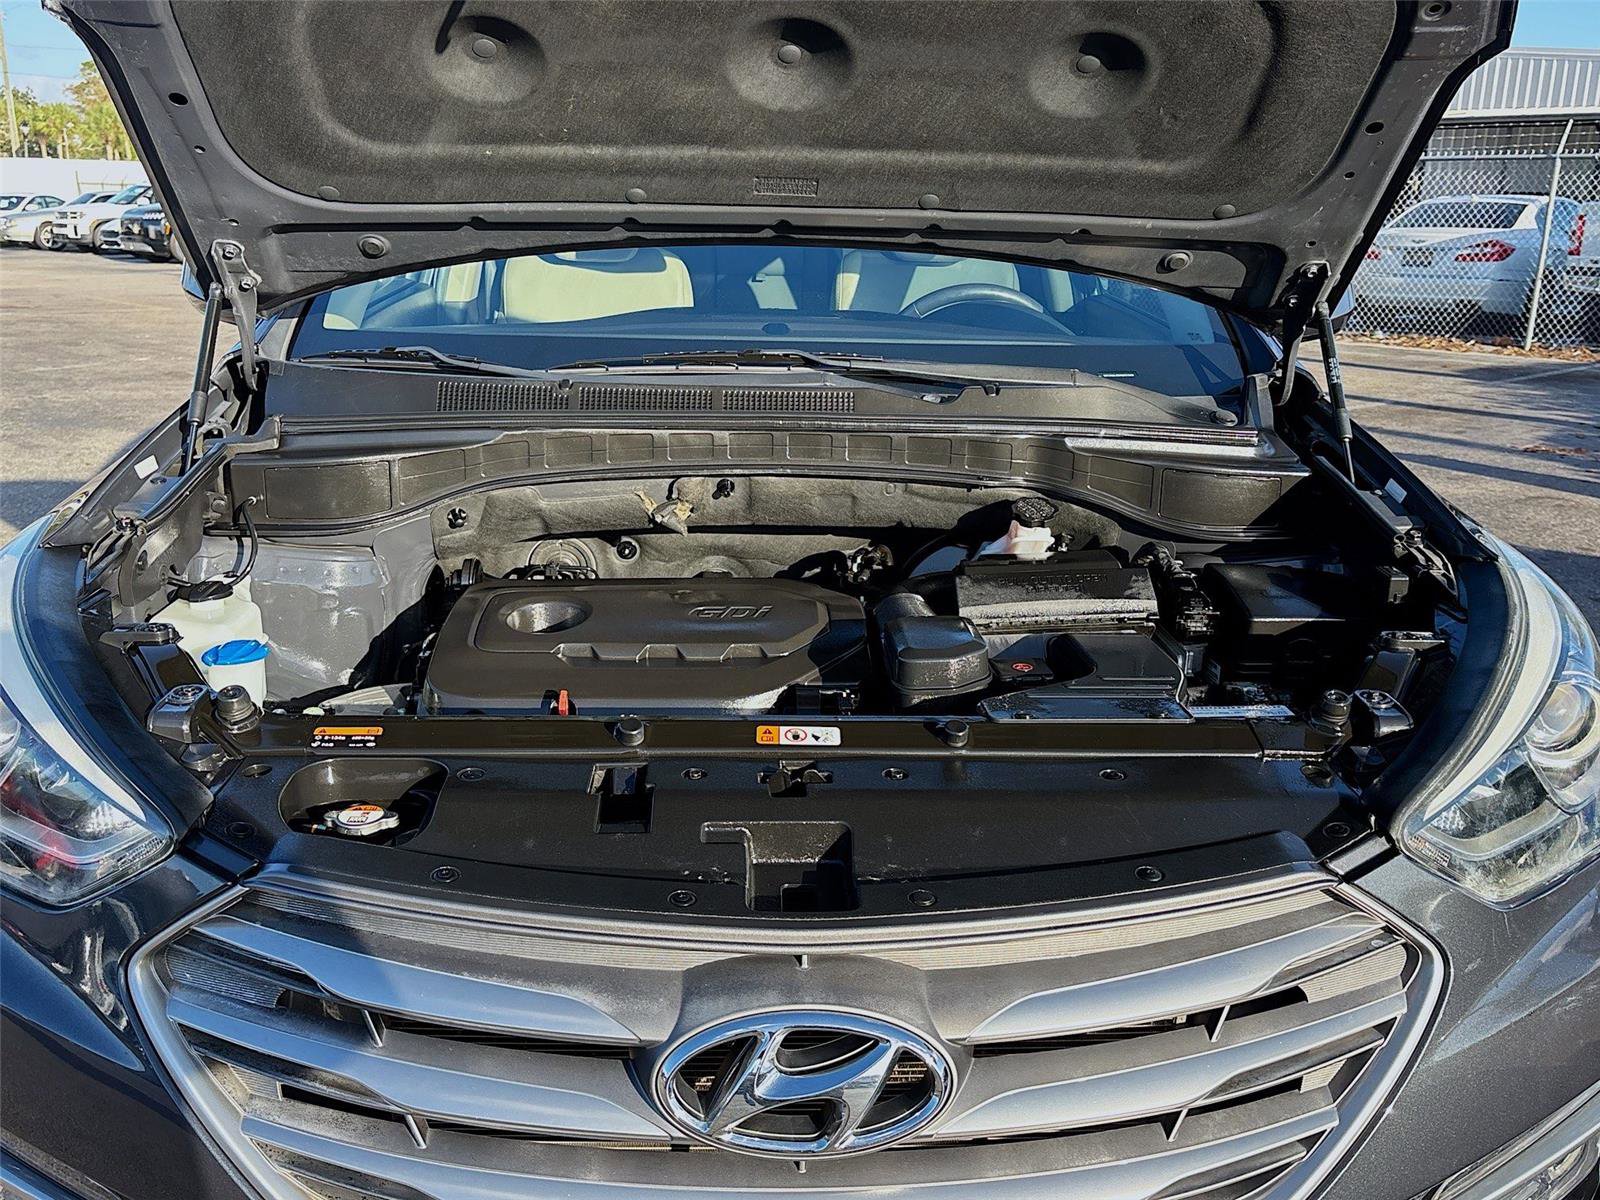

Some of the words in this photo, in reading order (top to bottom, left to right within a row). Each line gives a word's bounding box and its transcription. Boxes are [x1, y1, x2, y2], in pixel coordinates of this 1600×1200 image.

[1031, 575, 1056, 584] OUT
[1056, 574, 1072, 583] TO
[1075, 573, 1106, 582] OPEN
